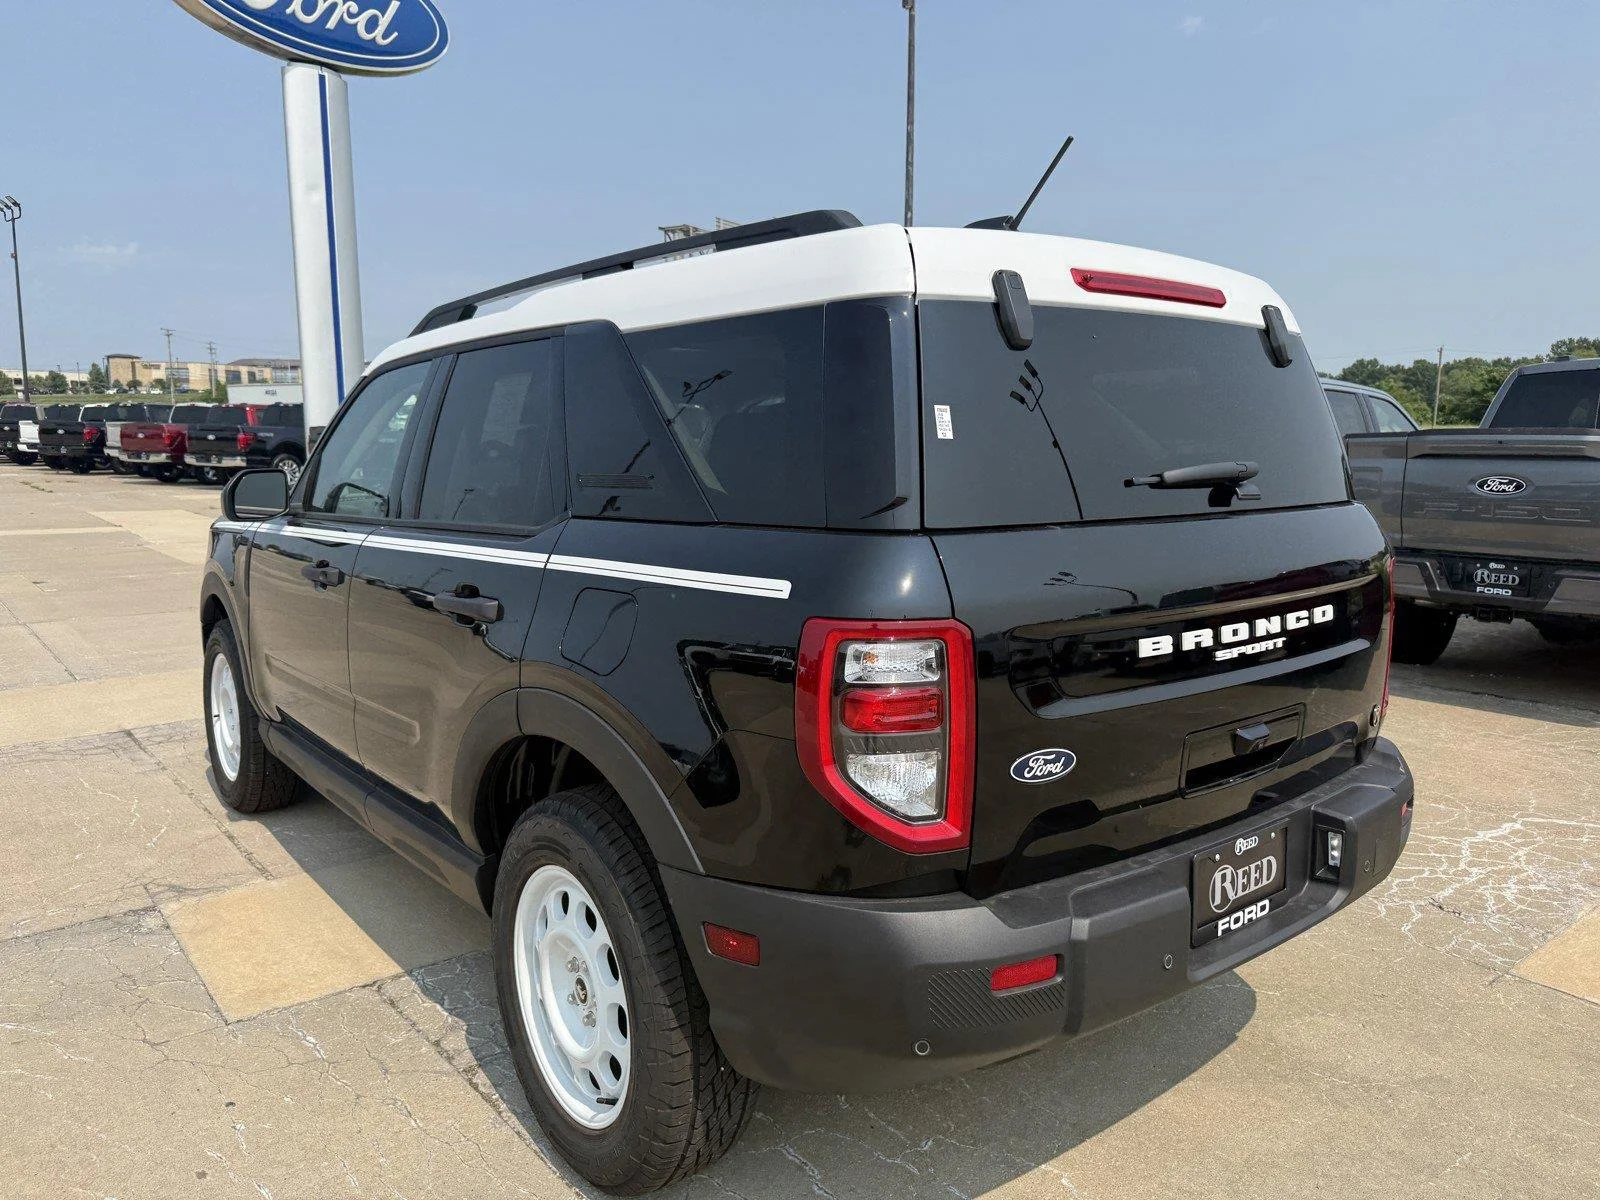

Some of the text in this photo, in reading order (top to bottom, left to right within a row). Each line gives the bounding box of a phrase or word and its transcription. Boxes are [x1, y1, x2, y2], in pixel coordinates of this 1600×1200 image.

[241, 0, 399, 46] ord
[1484, 478, 1517, 492] Ford
[1473, 568, 1520, 585] REED
[1476, 586, 1512, 596] FORD
[1138, 604, 1334, 659] BRONCO
[1213, 637, 1286, 661] SPORT
[1024, 754, 1066, 778] Ford
[1234, 836, 1259, 856] REED
[1209, 855, 1277, 913] REED
[1217, 899, 1270, 936] FORD
